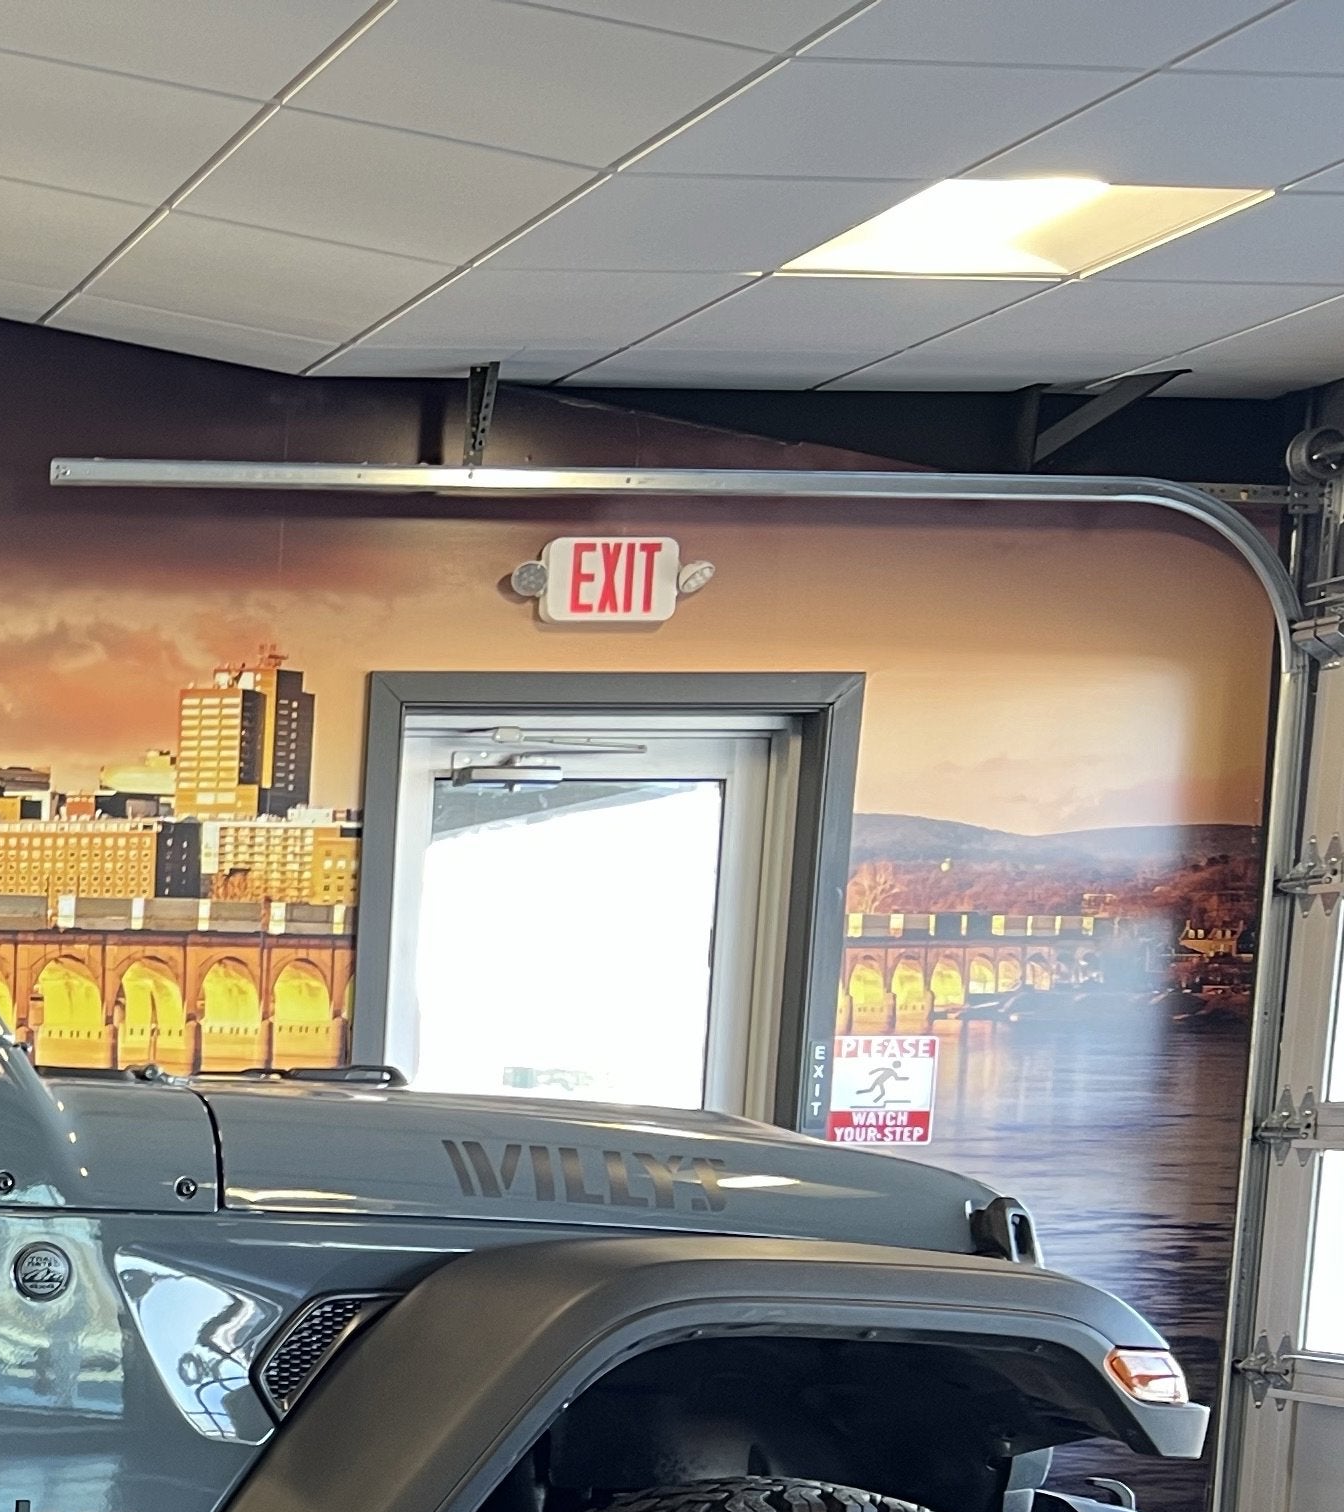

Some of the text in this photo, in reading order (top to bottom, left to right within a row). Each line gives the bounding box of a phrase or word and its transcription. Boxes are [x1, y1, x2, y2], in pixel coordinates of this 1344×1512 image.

[569, 542, 663, 613] EXIT
[840, 1038, 931, 1059] PLEASE
[810, 1045, 827, 1117] EXIT
[852, 1111, 909, 1126] WATCH
[833, 1127, 924, 1142] YOUR STEP
